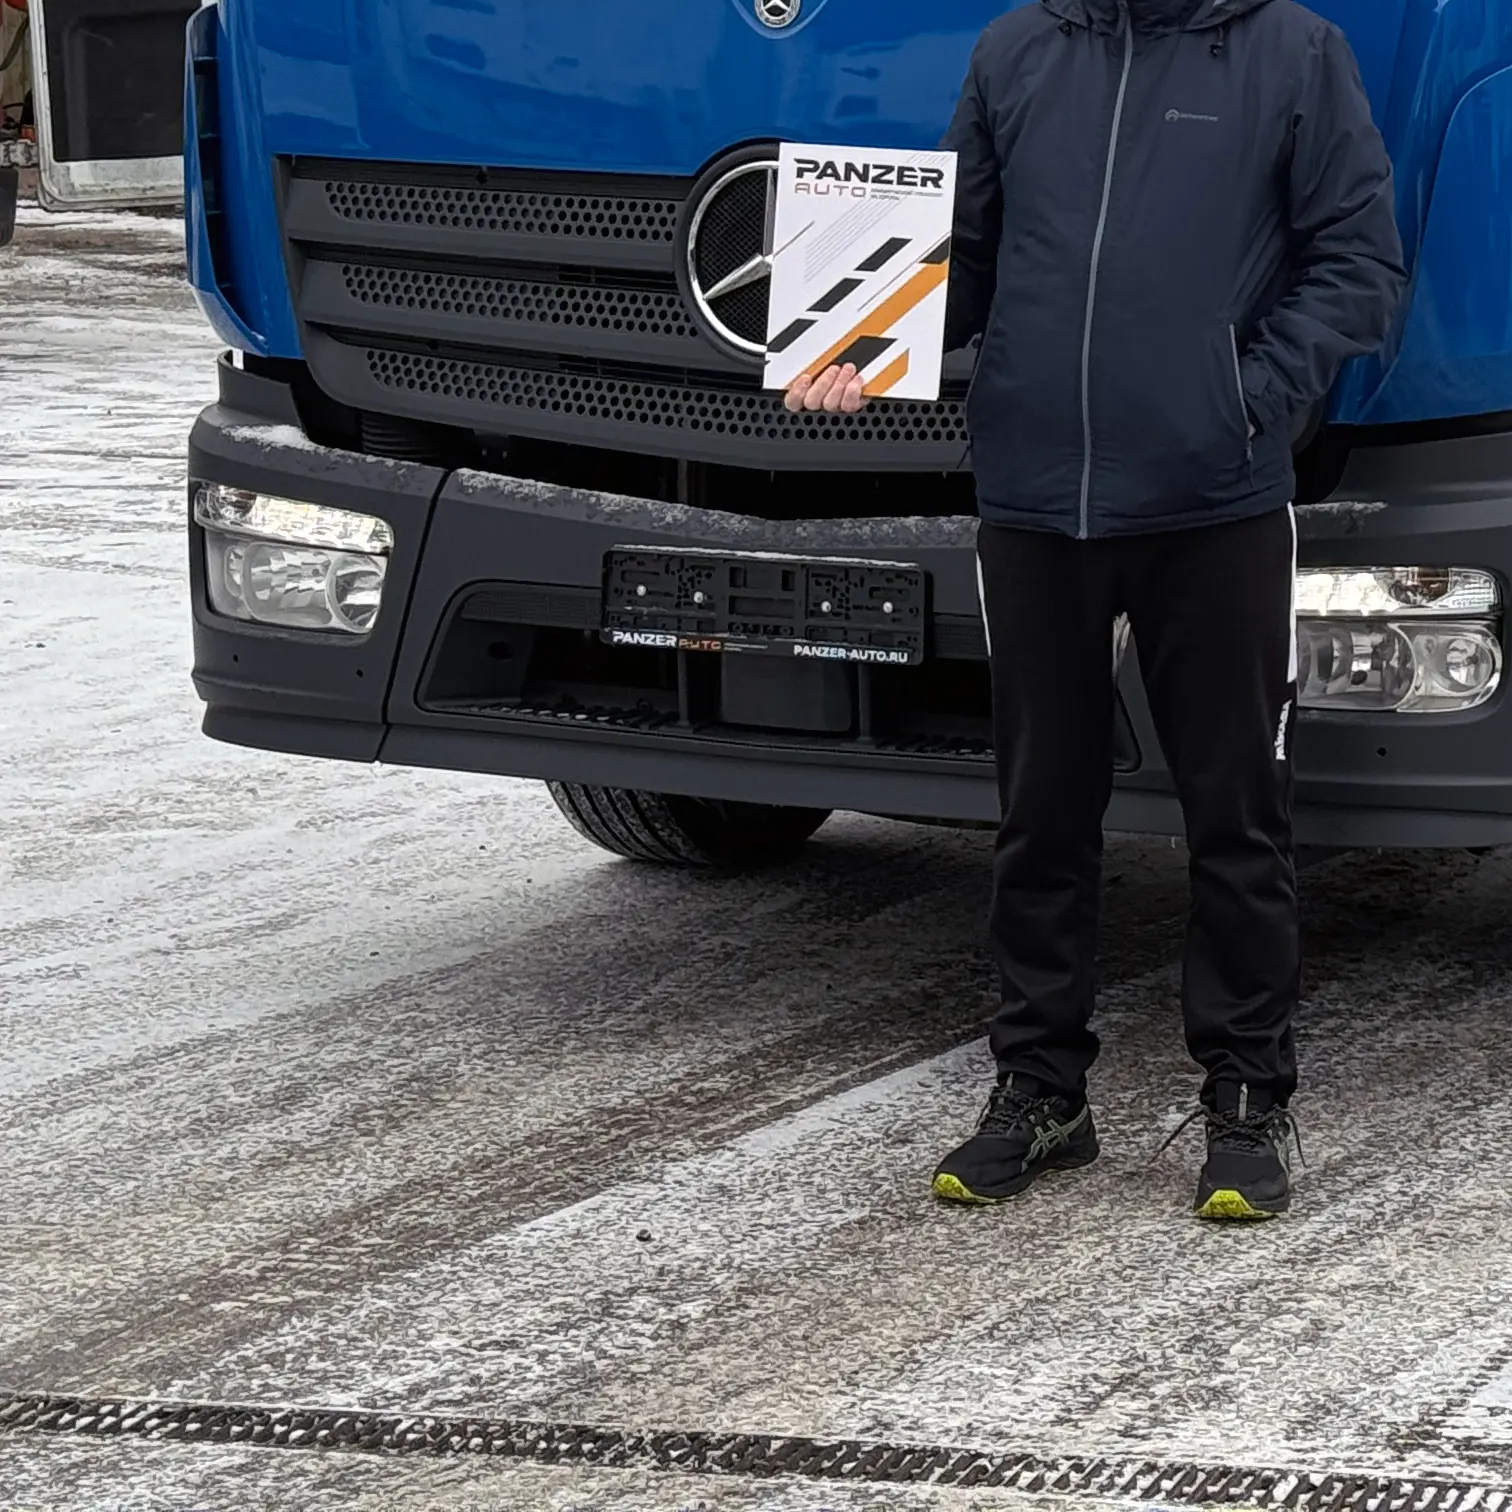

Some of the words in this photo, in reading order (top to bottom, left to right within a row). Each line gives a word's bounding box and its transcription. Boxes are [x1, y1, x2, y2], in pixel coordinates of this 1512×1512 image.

[793, 158, 944, 189] PANZER
[794, 183, 867, 198] AUTO
[612, 630, 678, 648] PANZER
